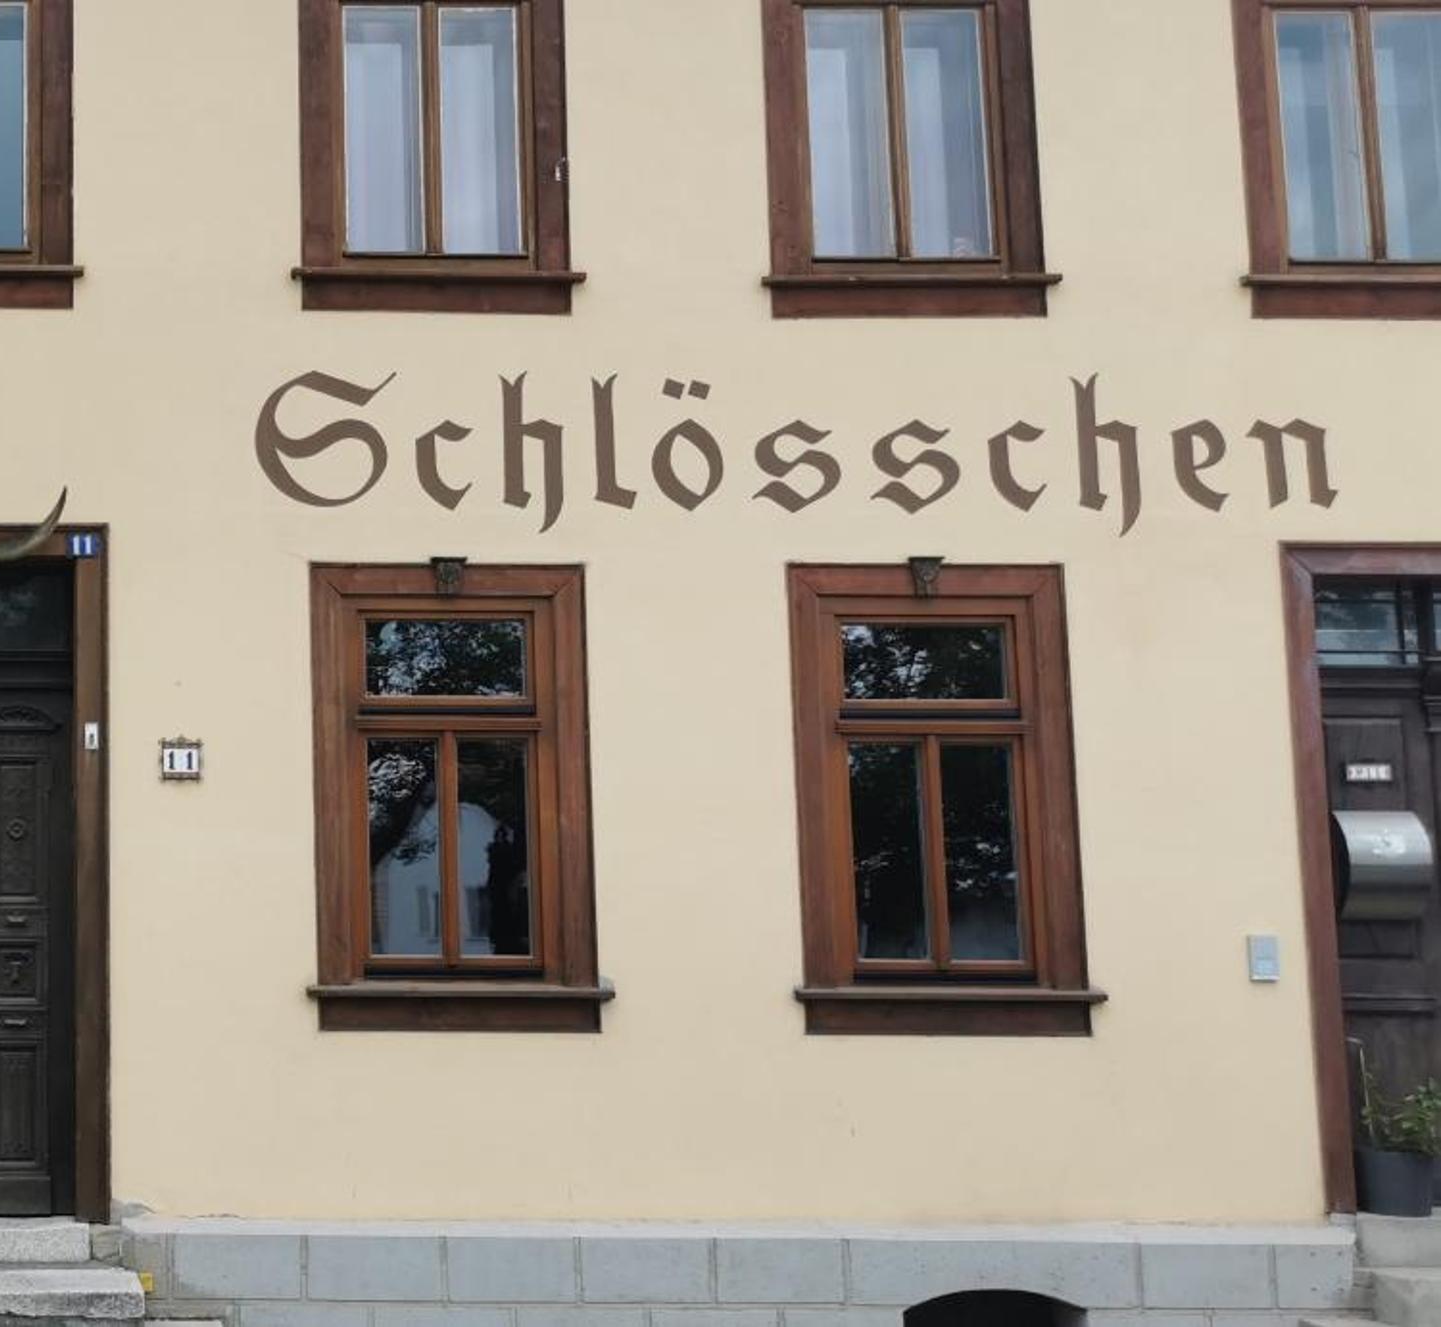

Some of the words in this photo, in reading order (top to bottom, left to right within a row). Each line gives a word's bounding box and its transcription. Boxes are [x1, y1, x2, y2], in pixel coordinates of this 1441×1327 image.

[254, 370, 1339, 538] Schlösschen
[72, 534, 91, 556] 11
[168, 750, 193, 770] 11
